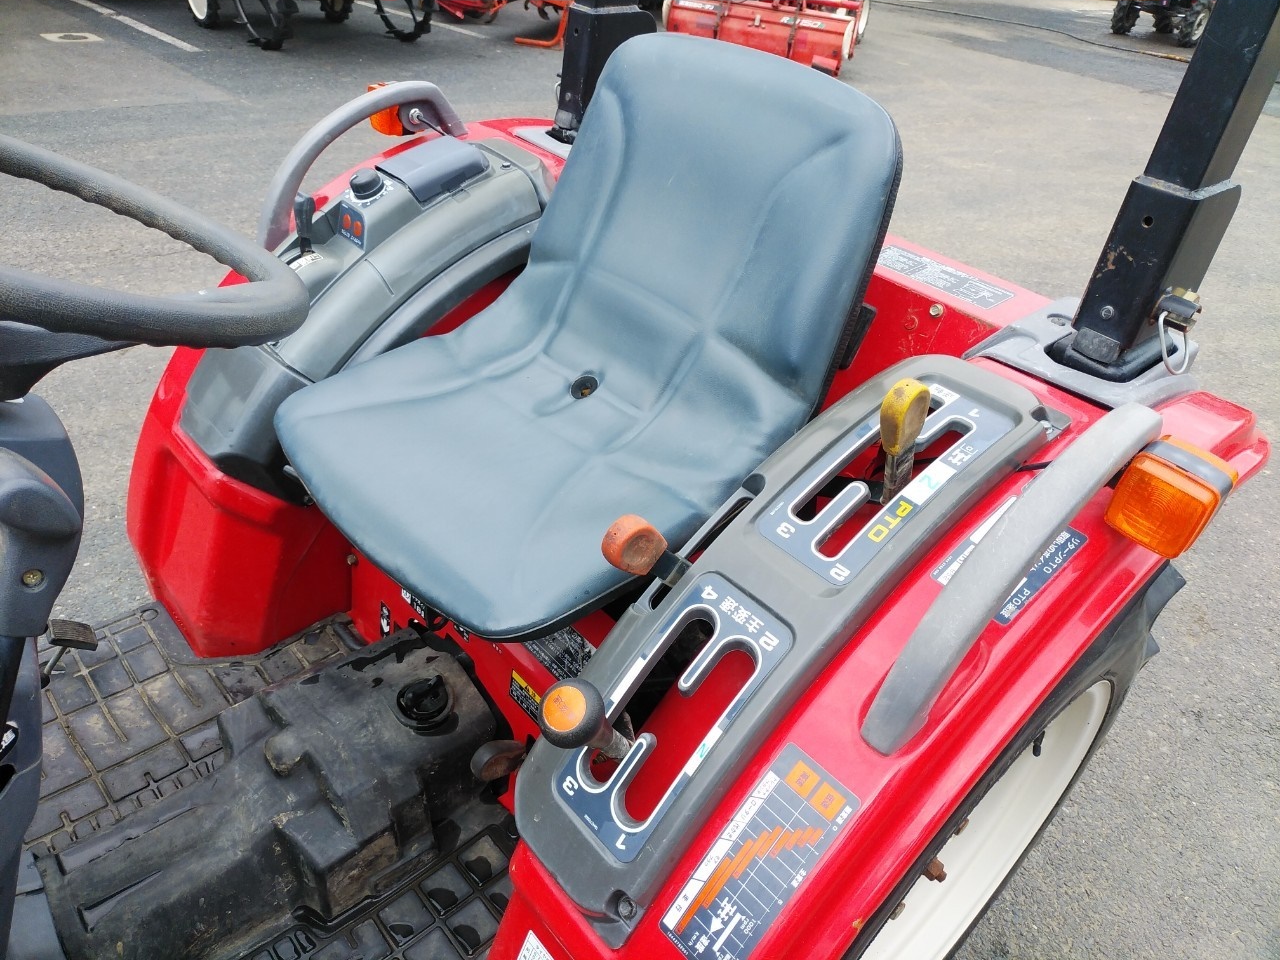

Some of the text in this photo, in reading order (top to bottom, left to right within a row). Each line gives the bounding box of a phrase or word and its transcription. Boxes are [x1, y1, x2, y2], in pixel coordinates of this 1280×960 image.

[776, 522, 795, 537] 3
[867, 501, 914, 543] PTO
[1042, 536, 1080, 575] リターンPTO
[830, 563, 850, 581] 2
[702, 585, 719, 601] 4
[719, 595, 764, 634] 主変速
[759, 632, 779, 651] 2
[563, 775, 578, 796] 3
